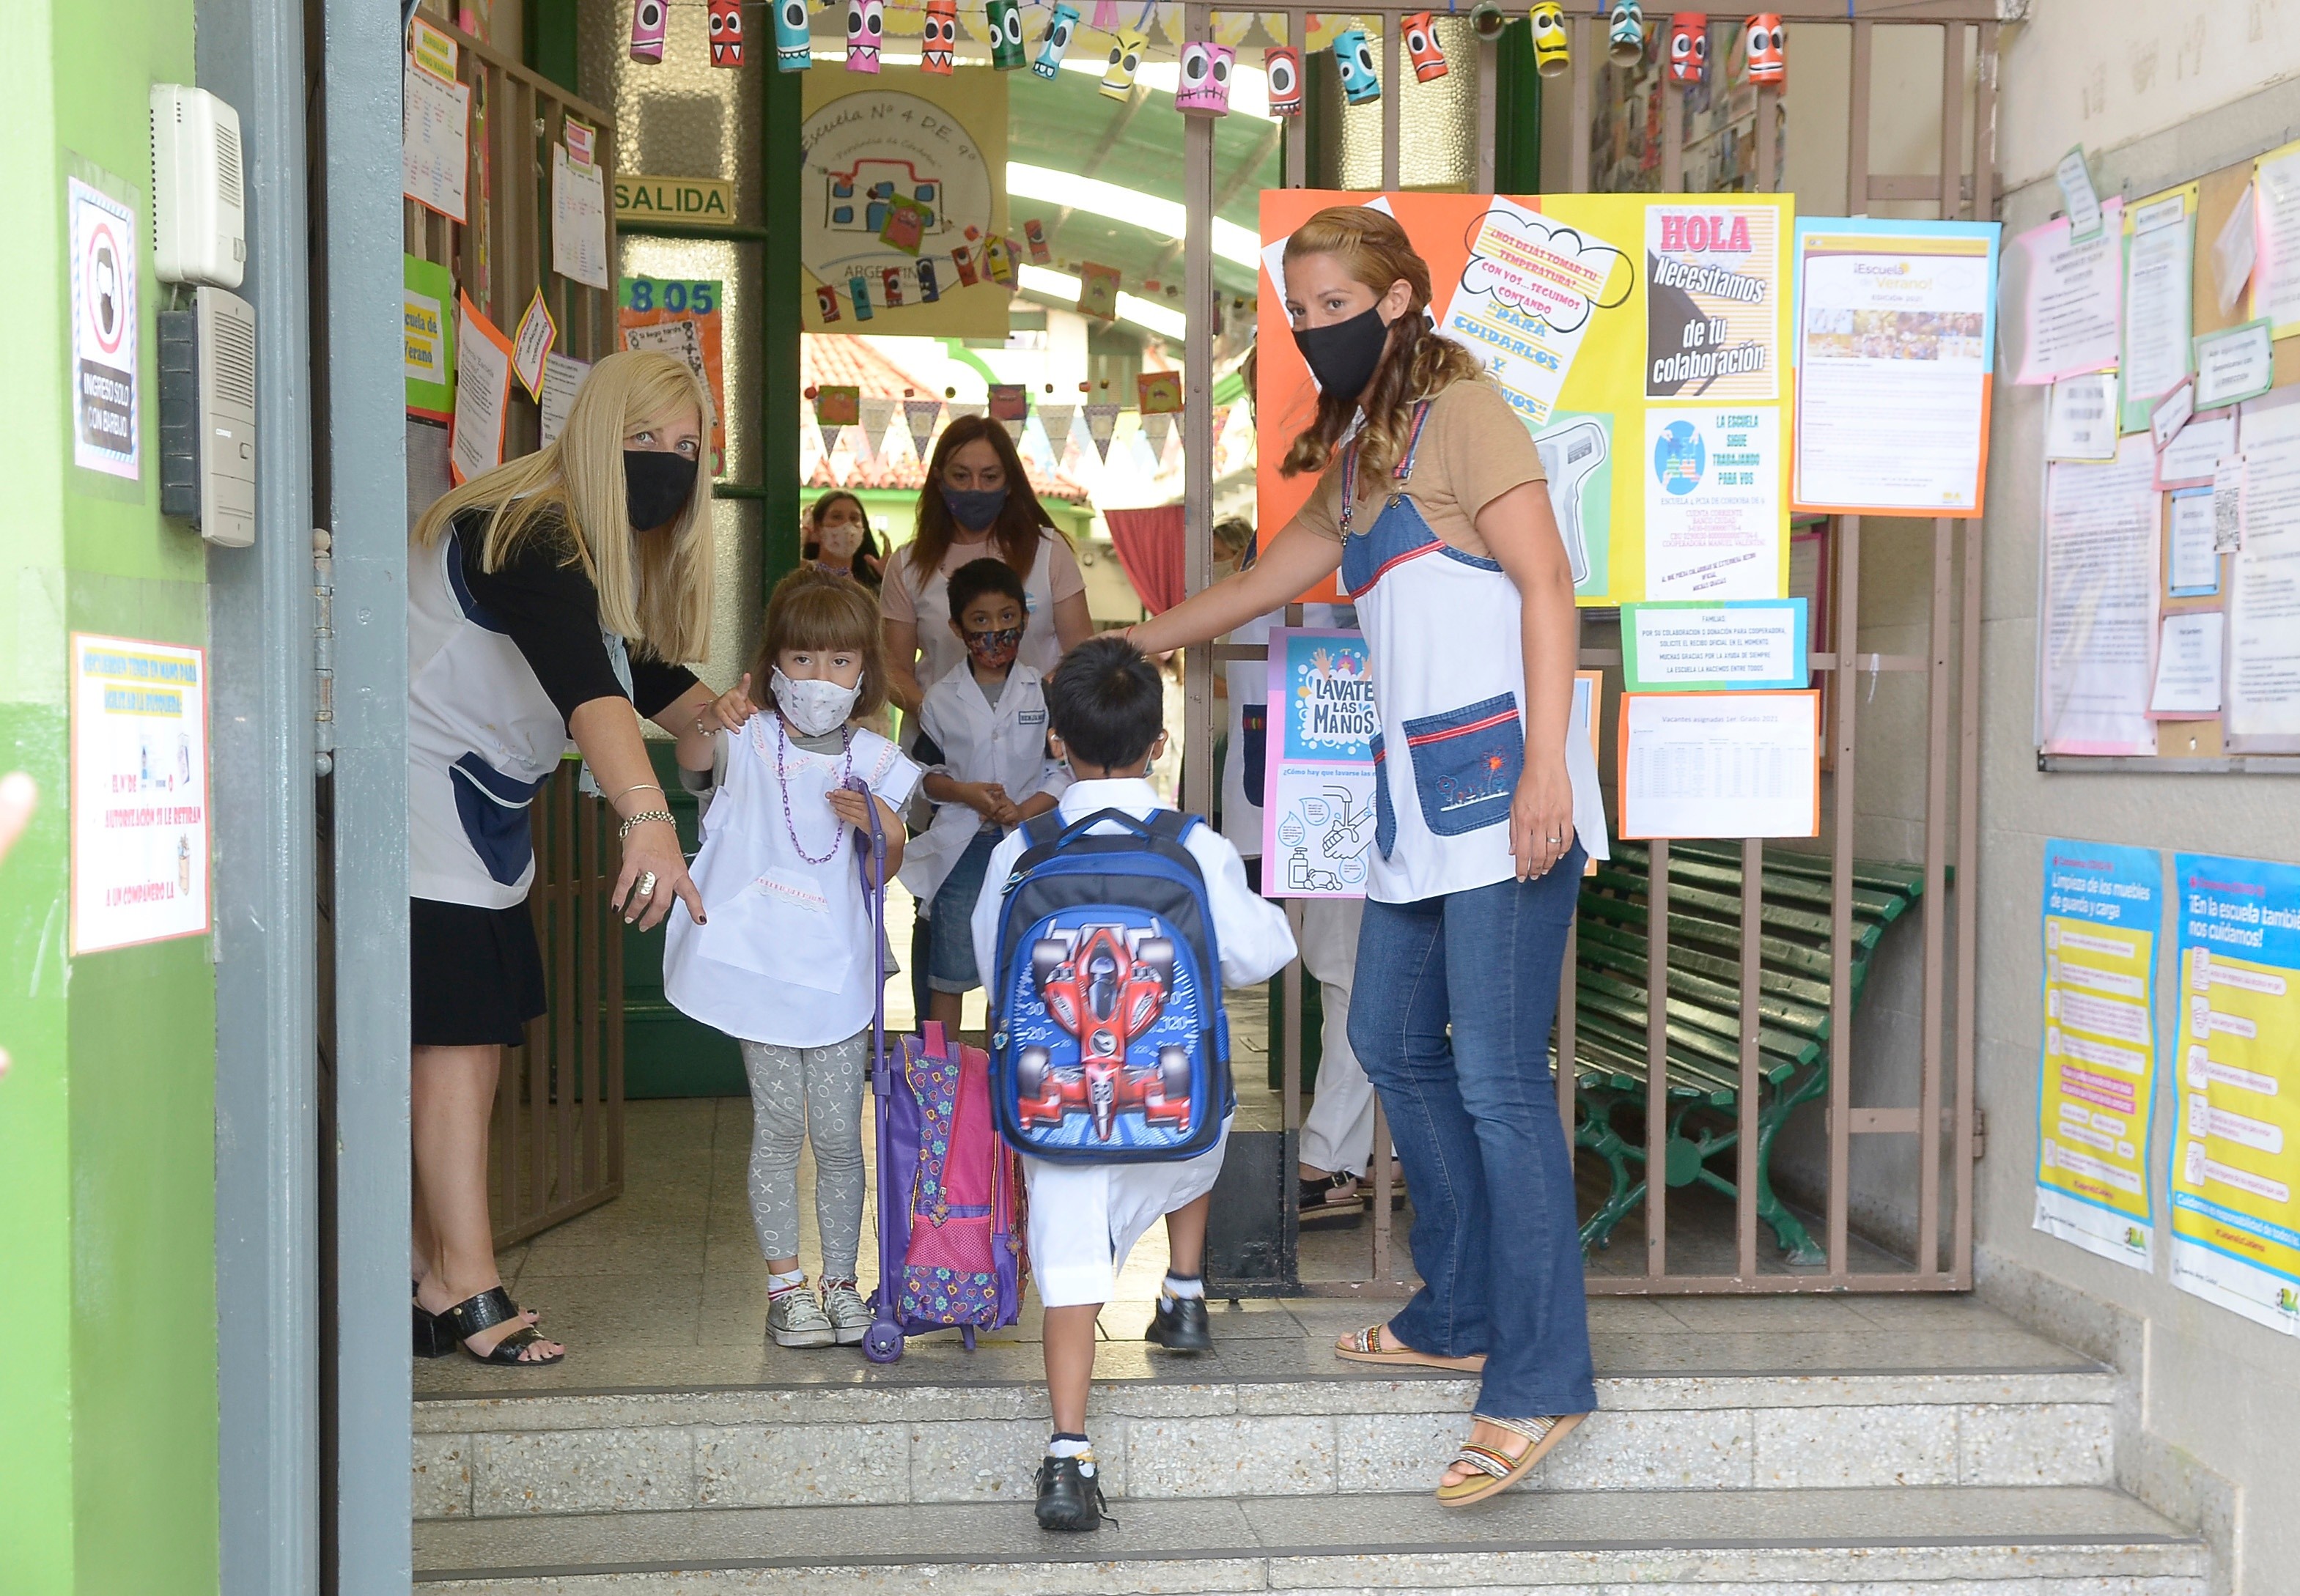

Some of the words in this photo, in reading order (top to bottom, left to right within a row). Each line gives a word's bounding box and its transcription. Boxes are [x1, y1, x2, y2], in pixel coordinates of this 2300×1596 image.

[902, 110, 913, 123] 4
[615, 185, 726, 213] SALIDA
[1660, 215, 1750, 251] HOLA
[1500, 249, 1577, 289] TEMPERATURA?
[1547, 253, 1582, 275] TOMAR
[1583, 268, 1597, 281] TU
[1654, 256, 1766, 303] Necesitamos
[1481, 262, 1502, 276] CON
[1531, 283, 1580, 310] SEGUIMOS
[1498, 287, 1552, 314] CONTANDO
[405, 312, 425, 333] cuela
[428, 316, 438, 333] de
[1683, 319, 1704, 348] de
[1709, 315, 1728, 345] tu
[1454, 316, 1559, 370] CUIDARLOS
[1493, 357, 1507, 372] Y
[1653, 339, 1765, 384] colaboración
[84, 372, 114, 402] INGRESO
[114, 382, 129, 407] SOLO
[89, 406, 102, 430] CON
[103, 410, 127, 437] BARBIJO
[1716, 415, 1725, 428] LA
[1728, 415, 1758, 428] ESCUELA
[1316, 675, 1375, 701] LÁVATE
[1313, 704, 1374, 735] MANOS
[1333, 702, 1357, 714] LAS
[1283, 768, 1305, 776] ¿Cómo
[166, 882, 174, 899] LA
[2052, 872, 2086, 892] Limpieza
[2087, 876, 2098, 893] de
[2099, 878, 2112, 895] los
[2113, 882, 2150, 901] muebles
[2050, 892, 2061, 909] de
[2062, 895, 2089, 913] guarda
[2089, 902, 2095, 917] y
[2096, 902, 2120, 920] carga
[2208, 896, 2219, 917] la
[2219, 902, 2260, 924] escuela
[2189, 920, 2208, 938] nos
[2208, 921, 2263, 948] cuidamos!
